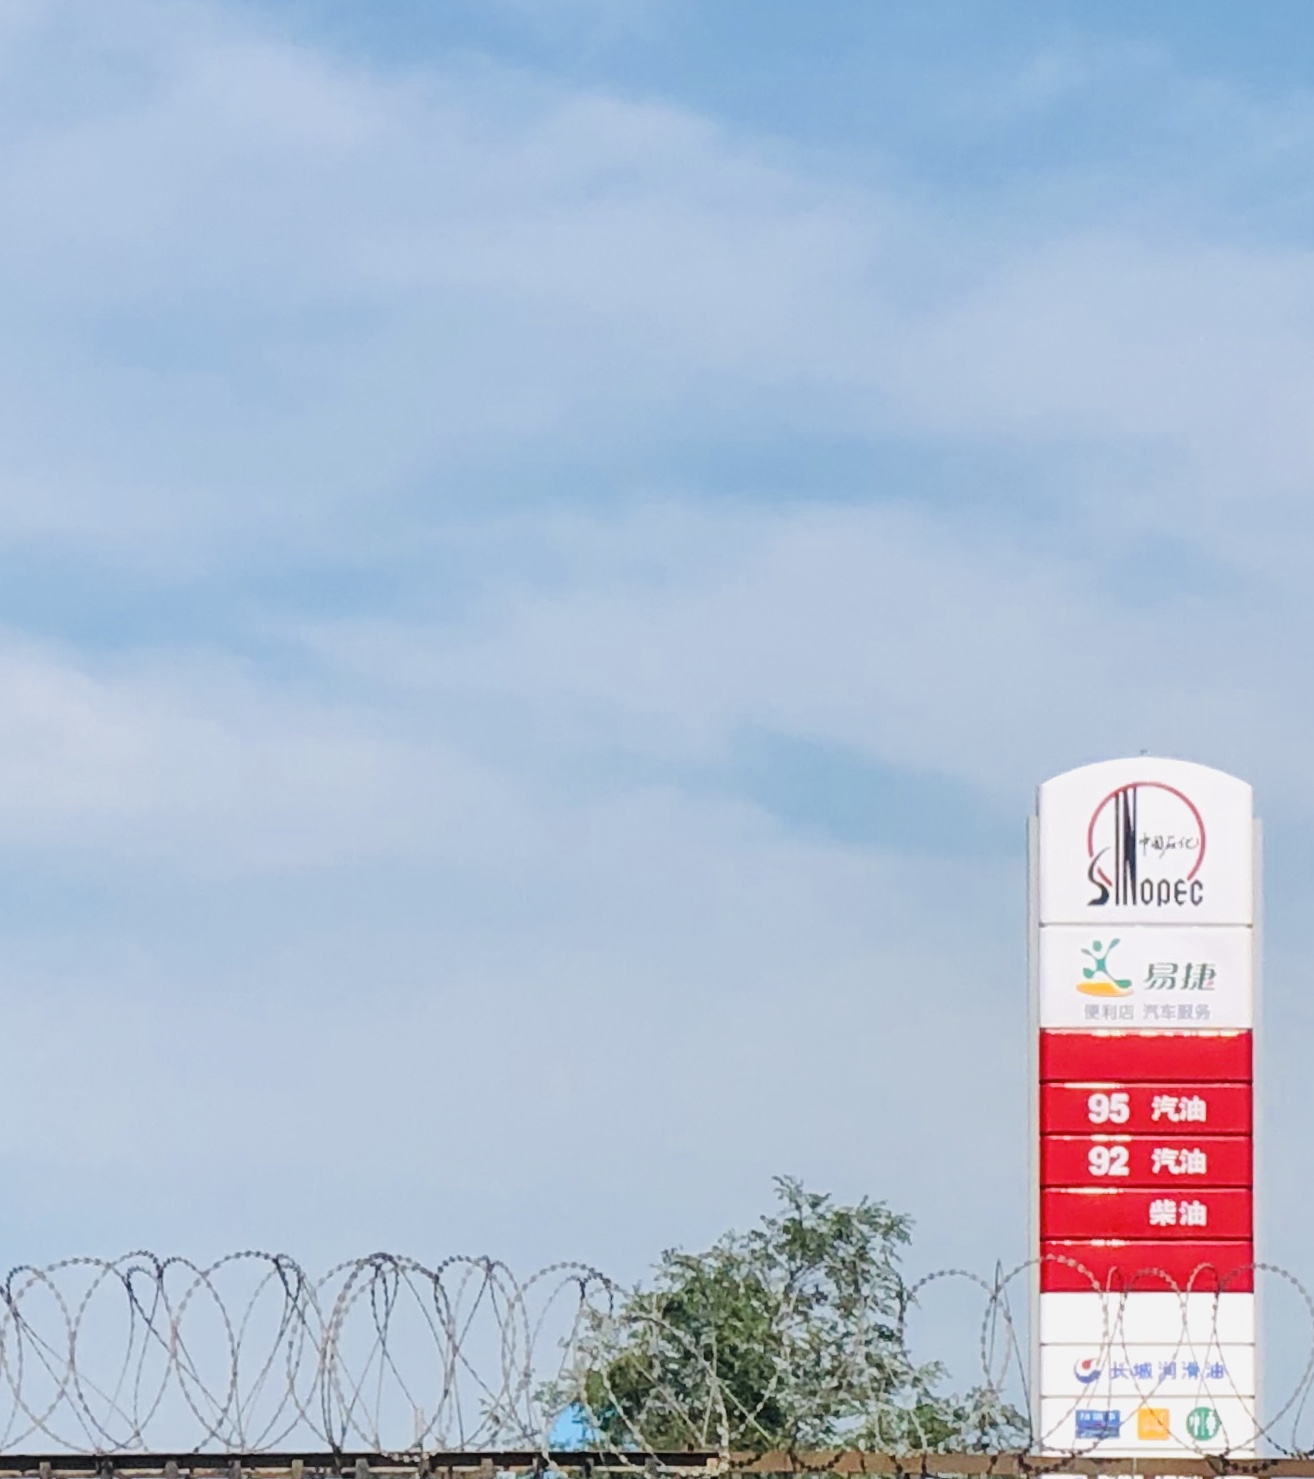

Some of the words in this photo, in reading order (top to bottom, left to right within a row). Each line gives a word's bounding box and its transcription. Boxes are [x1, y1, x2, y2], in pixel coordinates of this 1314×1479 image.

[1143, 962, 1216, 991] 易捷
[1084, 1004, 1134, 1020] 便利店
[1143, 1004, 1211, 1020] 汽车服务
[1088, 1093, 1130, 1124] 95
[1151, 1095, 1207, 1122] 汽油
[1088, 1146, 1130, 1176] 92
[1151, 1148, 1207, 1175] 汽油
[1149, 1199, 1207, 1227] 柴油
